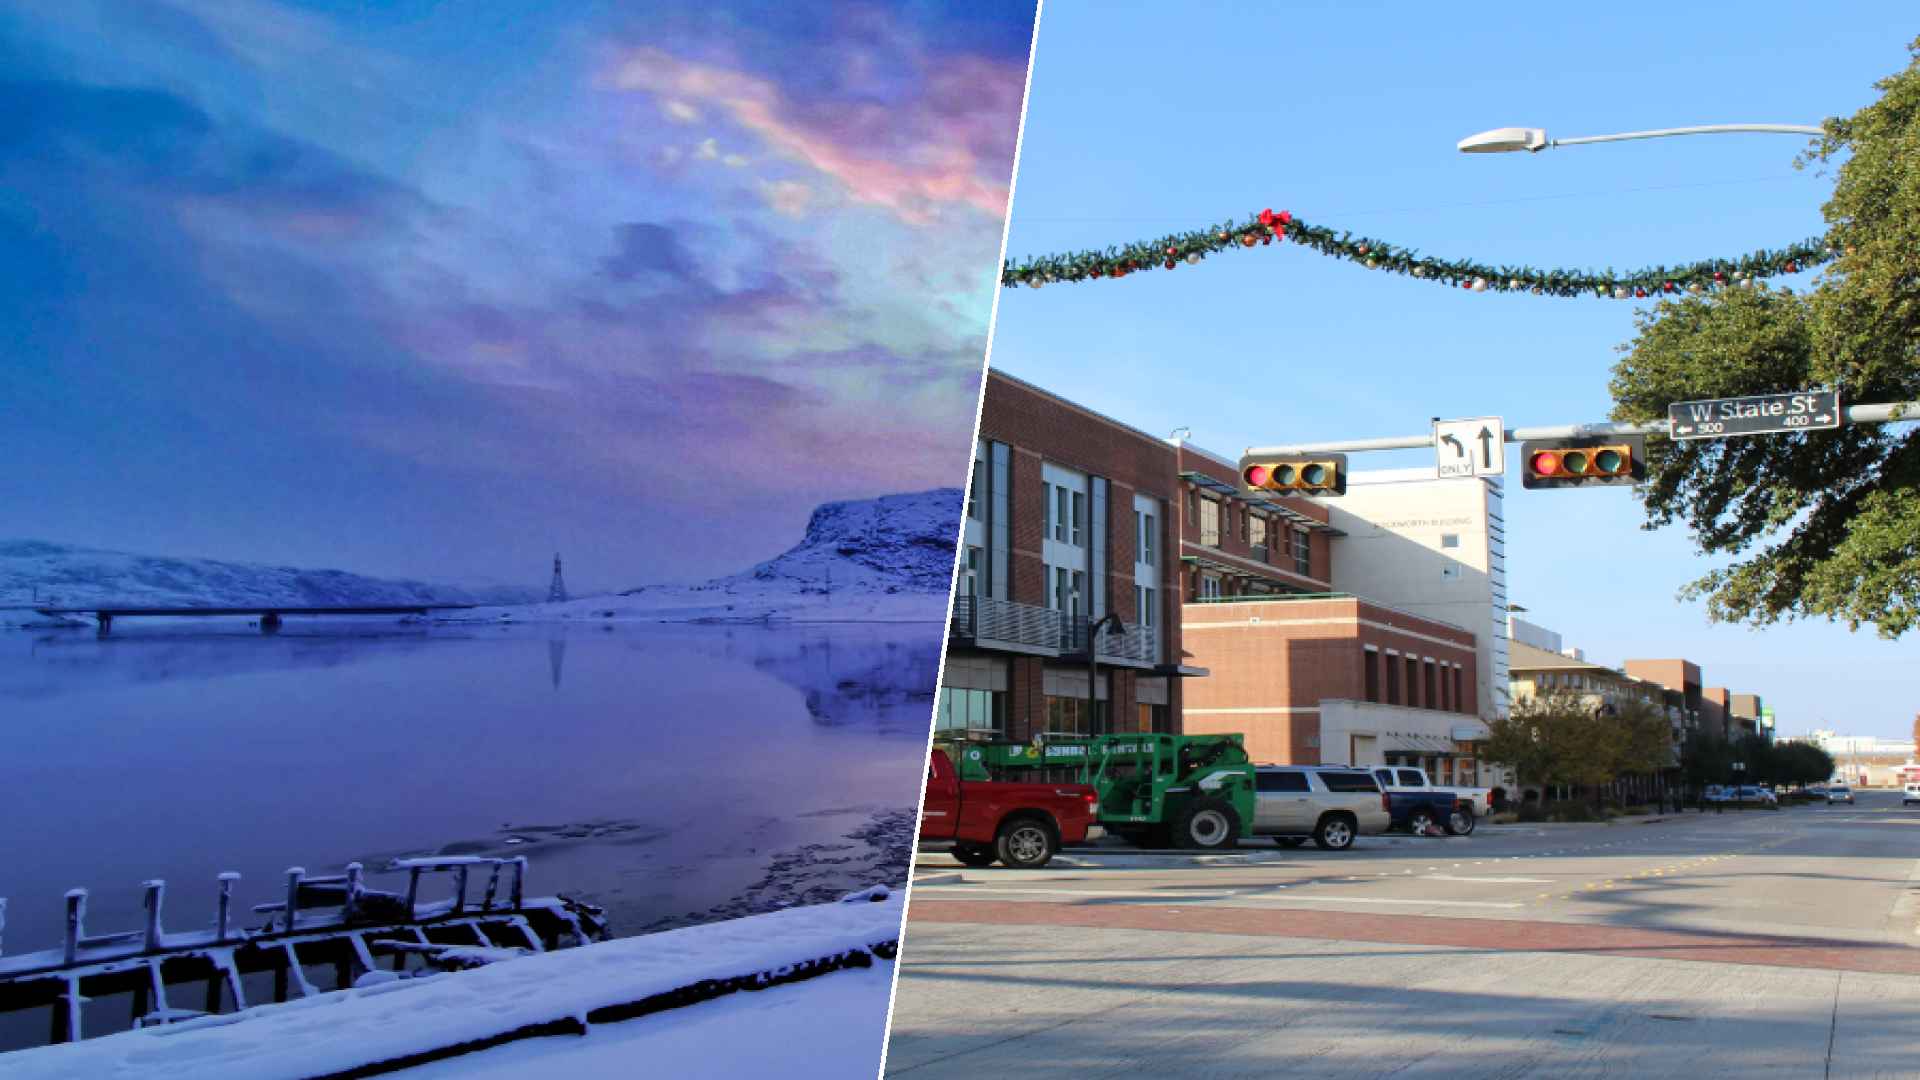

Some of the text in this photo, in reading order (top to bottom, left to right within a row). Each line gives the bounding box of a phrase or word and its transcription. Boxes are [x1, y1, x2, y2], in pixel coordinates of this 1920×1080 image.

[1690, 395, 1817, 422] W State St
[1783, 415, 1810, 426] 400
[1440, 464, 1472, 475] ONLY
